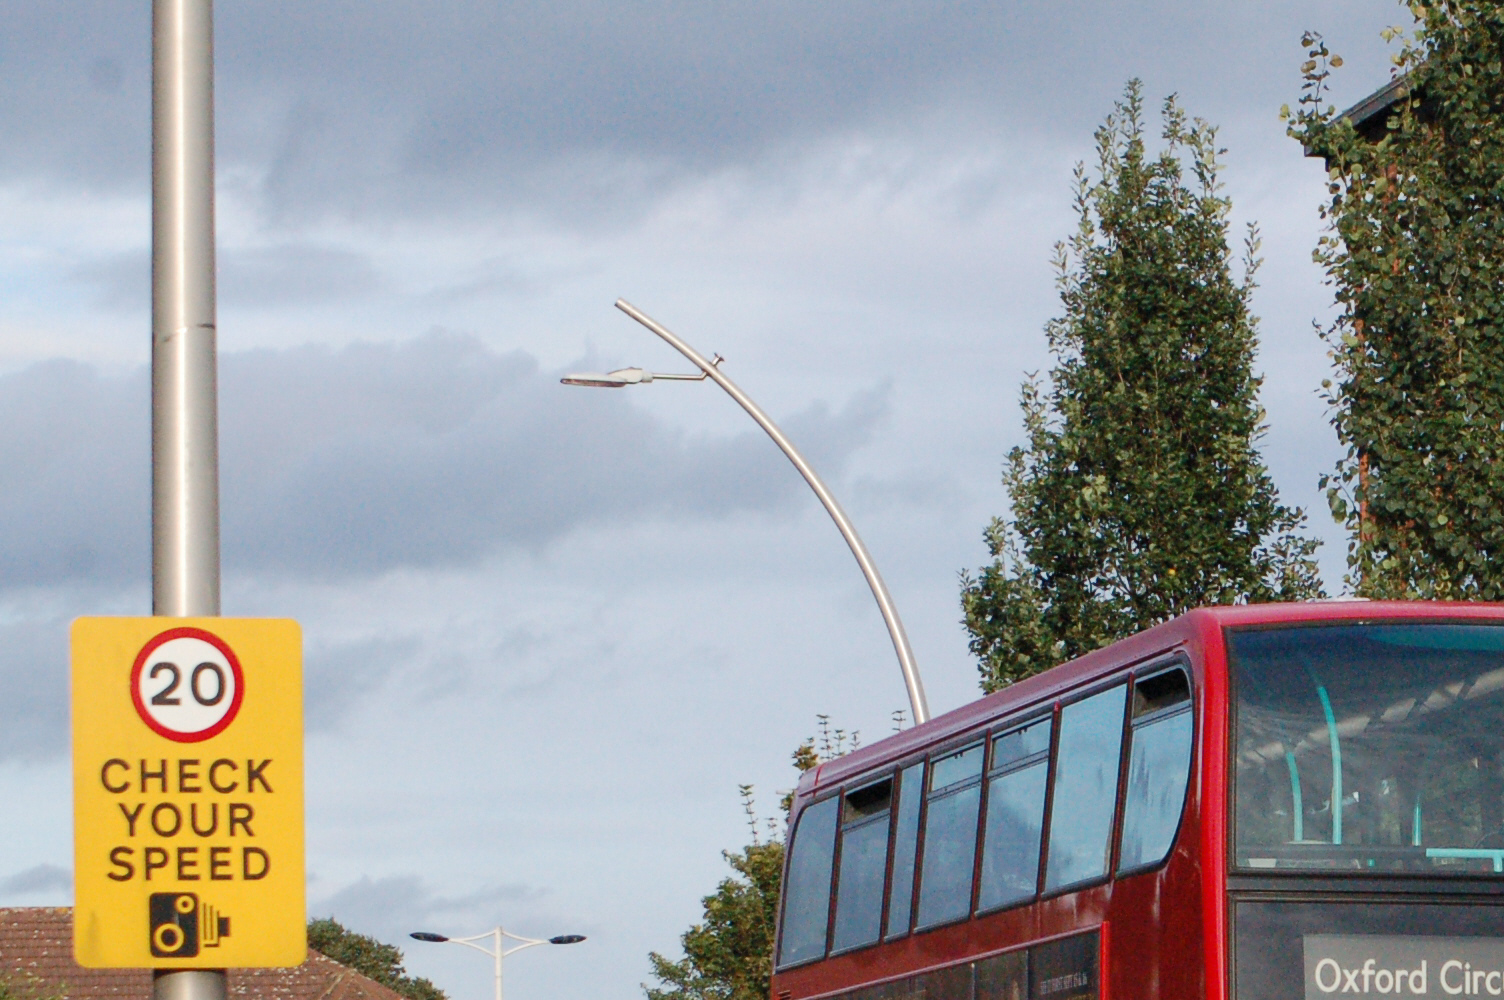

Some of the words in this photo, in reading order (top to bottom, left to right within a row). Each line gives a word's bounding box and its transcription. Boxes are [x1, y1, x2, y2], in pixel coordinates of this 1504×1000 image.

[150, 661, 227, 707] 20
[101, 758, 274, 794] CHECK
[118, 802, 256, 838] YOUR
[107, 845, 271, 882] SPEED
[1315, 957, 1428, 994] Oxford
